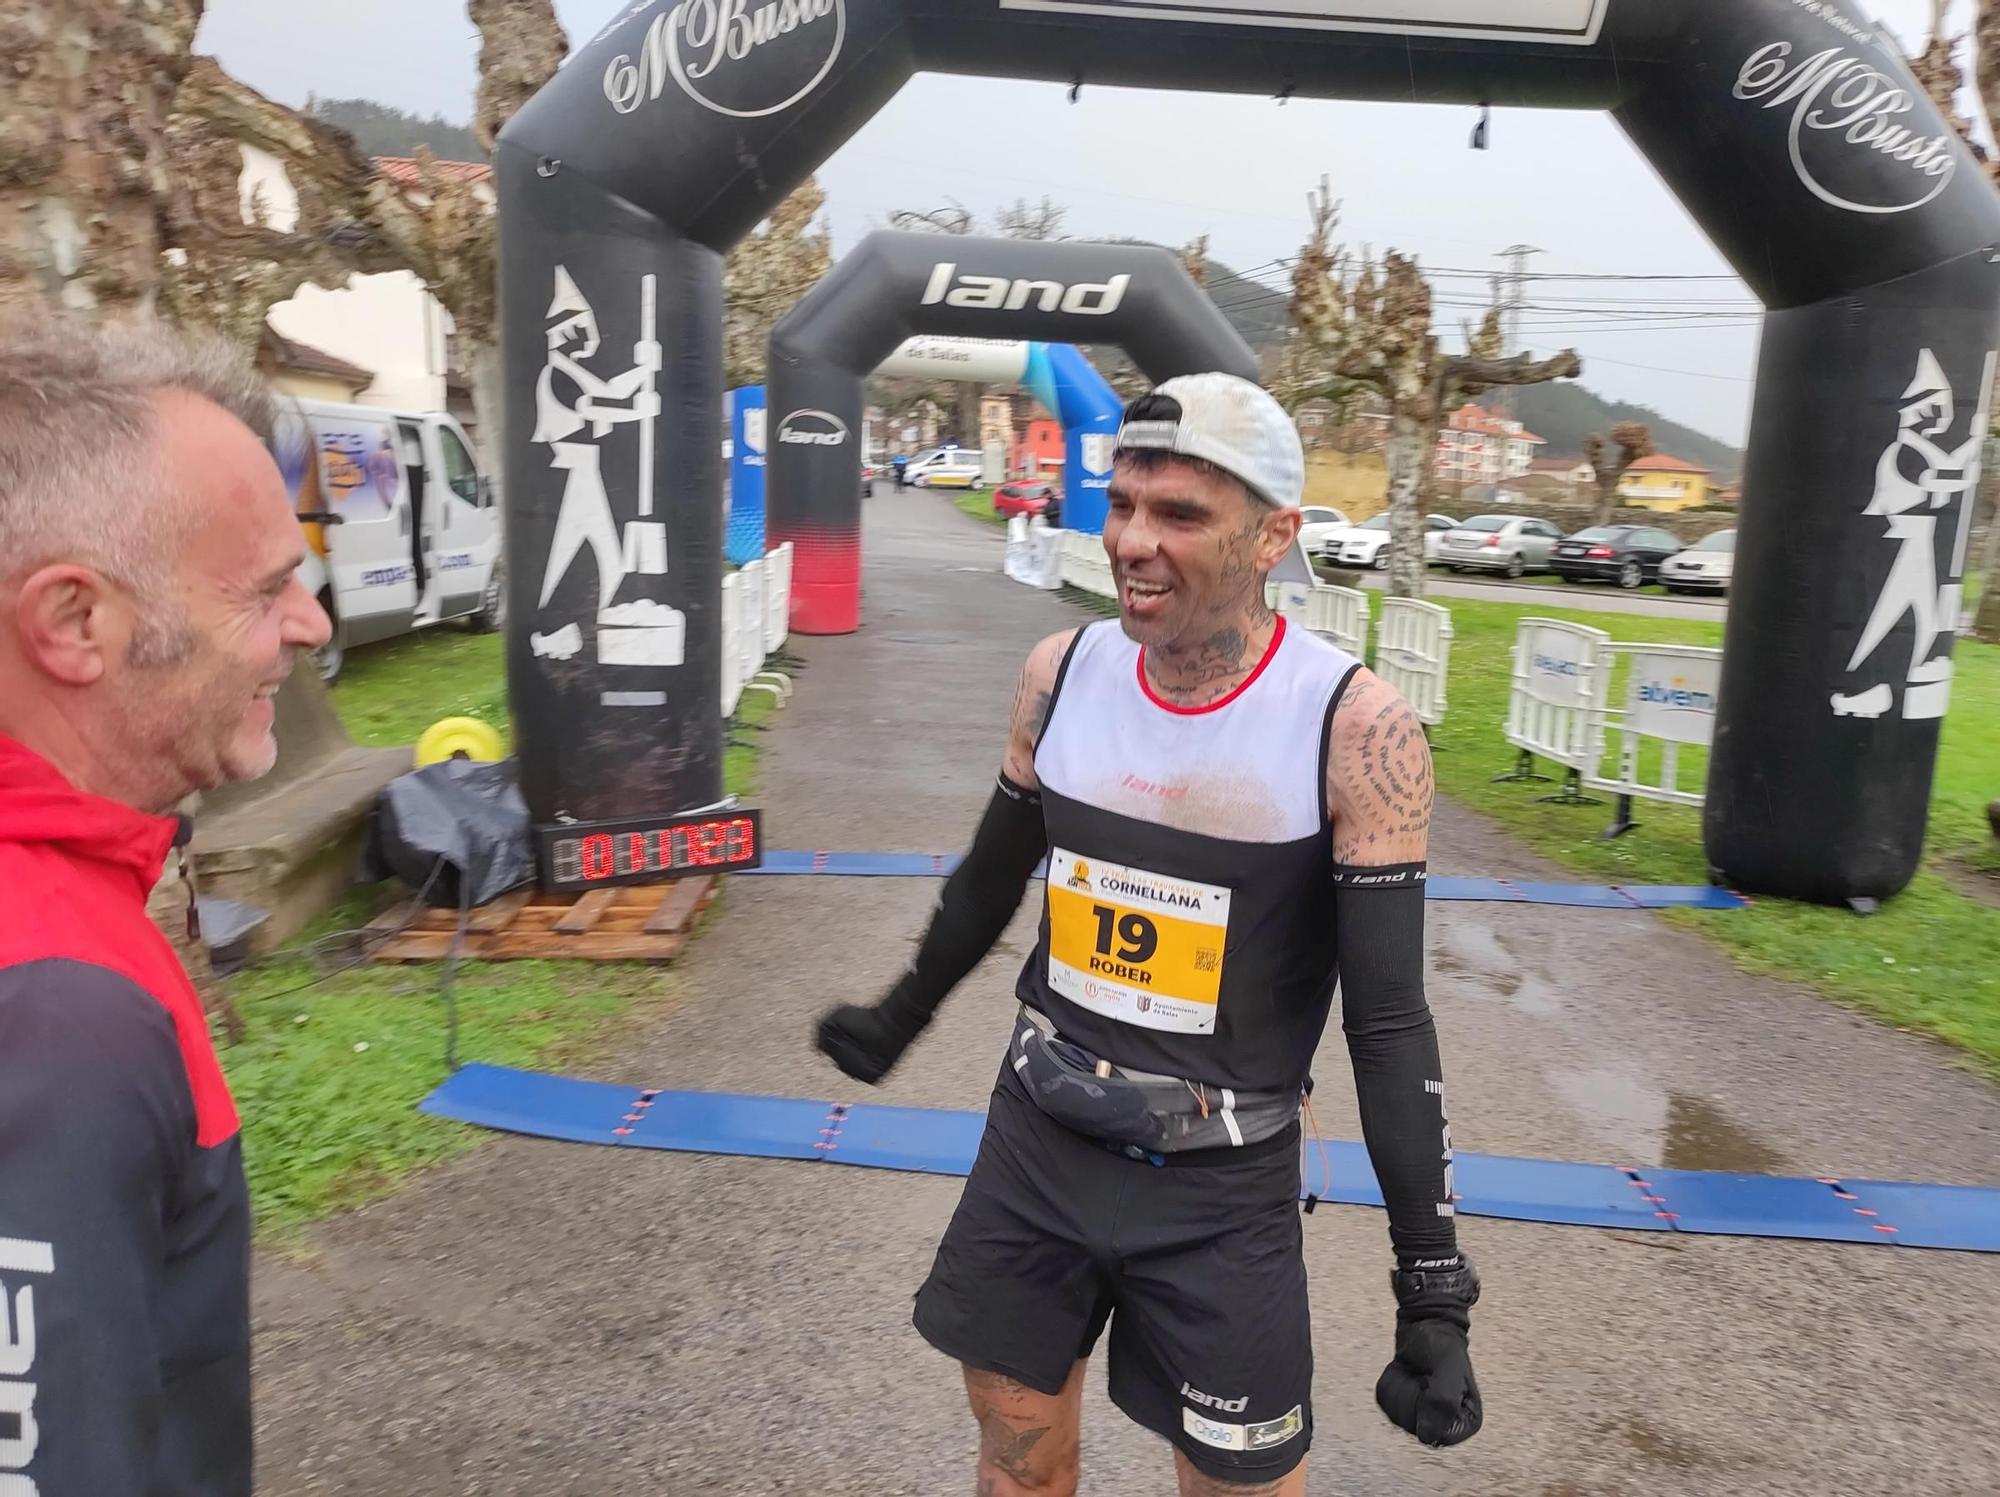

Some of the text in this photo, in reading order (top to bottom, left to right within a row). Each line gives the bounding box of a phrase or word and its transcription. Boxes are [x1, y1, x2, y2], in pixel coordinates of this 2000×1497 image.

[921, 262, 1131, 315] land
[779, 427, 846, 445] land
[1122, 774, 1189, 799] land
[1352, 872, 1407, 884] land
[1100, 877, 1202, 910] CORNELLANA
[1093, 904, 1158, 964] 19
[1089, 956, 1152, 985] ROBER
[1154, 1002, 1199, 1015] Ayuntamiento
[1181, 1381, 1249, 1413] land
